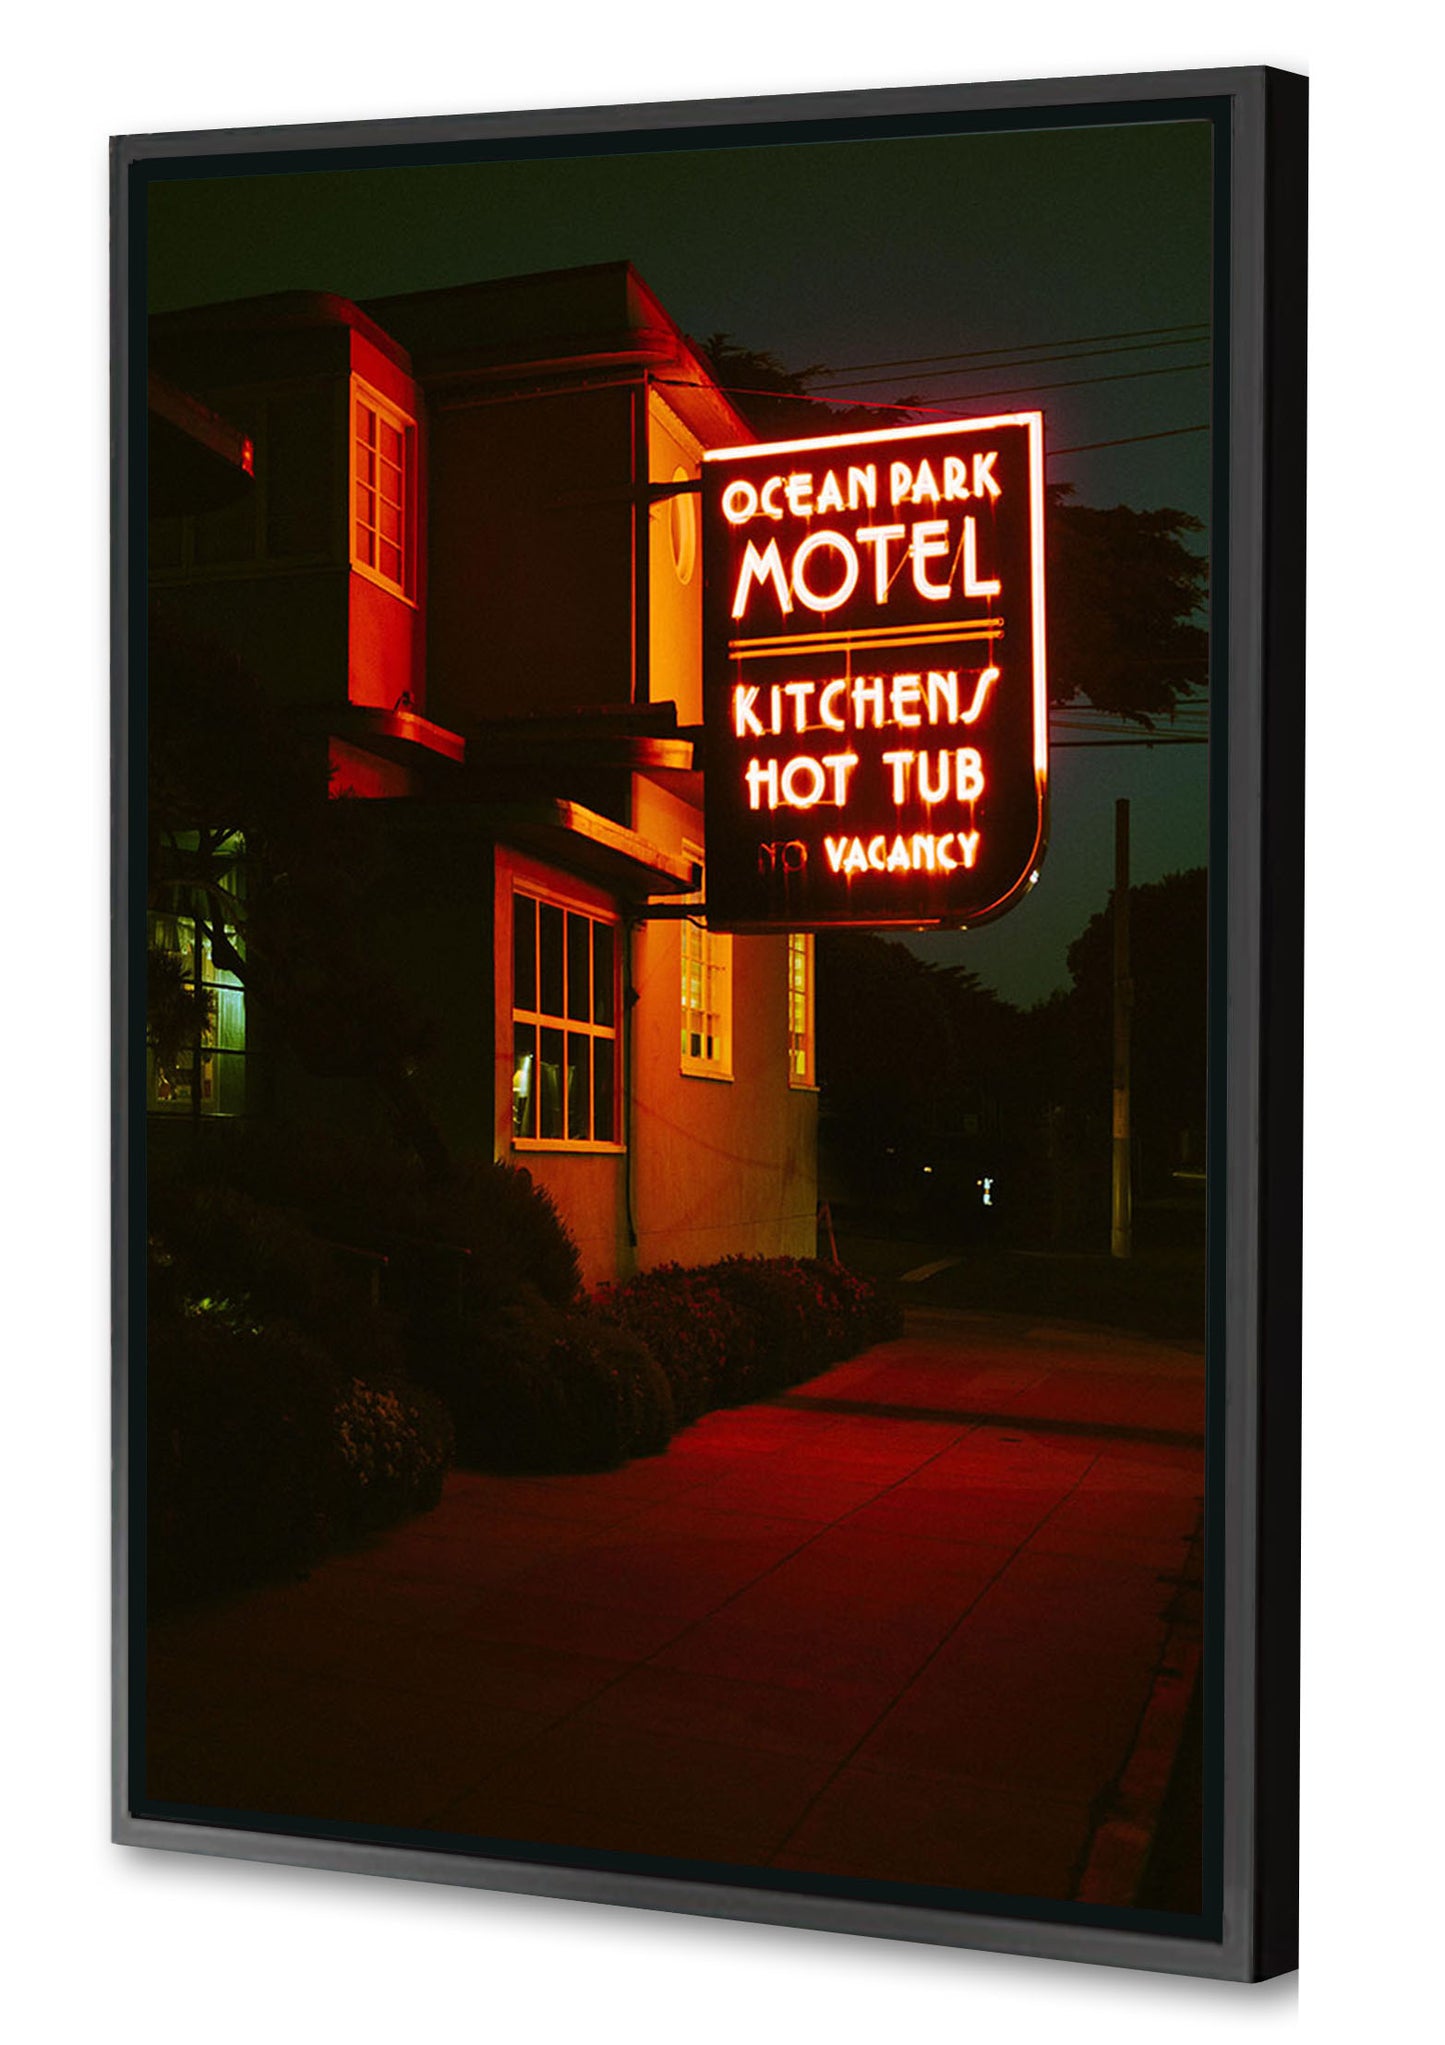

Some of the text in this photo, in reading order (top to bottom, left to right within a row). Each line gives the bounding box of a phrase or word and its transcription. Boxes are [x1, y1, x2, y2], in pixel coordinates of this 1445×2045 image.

[722, 452, 1001, 524] OCEAN PARK
[731, 516, 1001, 618] MOTEL
[735, 667, 999, 737] KITCHENS
[745, 748, 985, 810] HOT TUB
[758, 832, 980, 874] NO VACANCY
